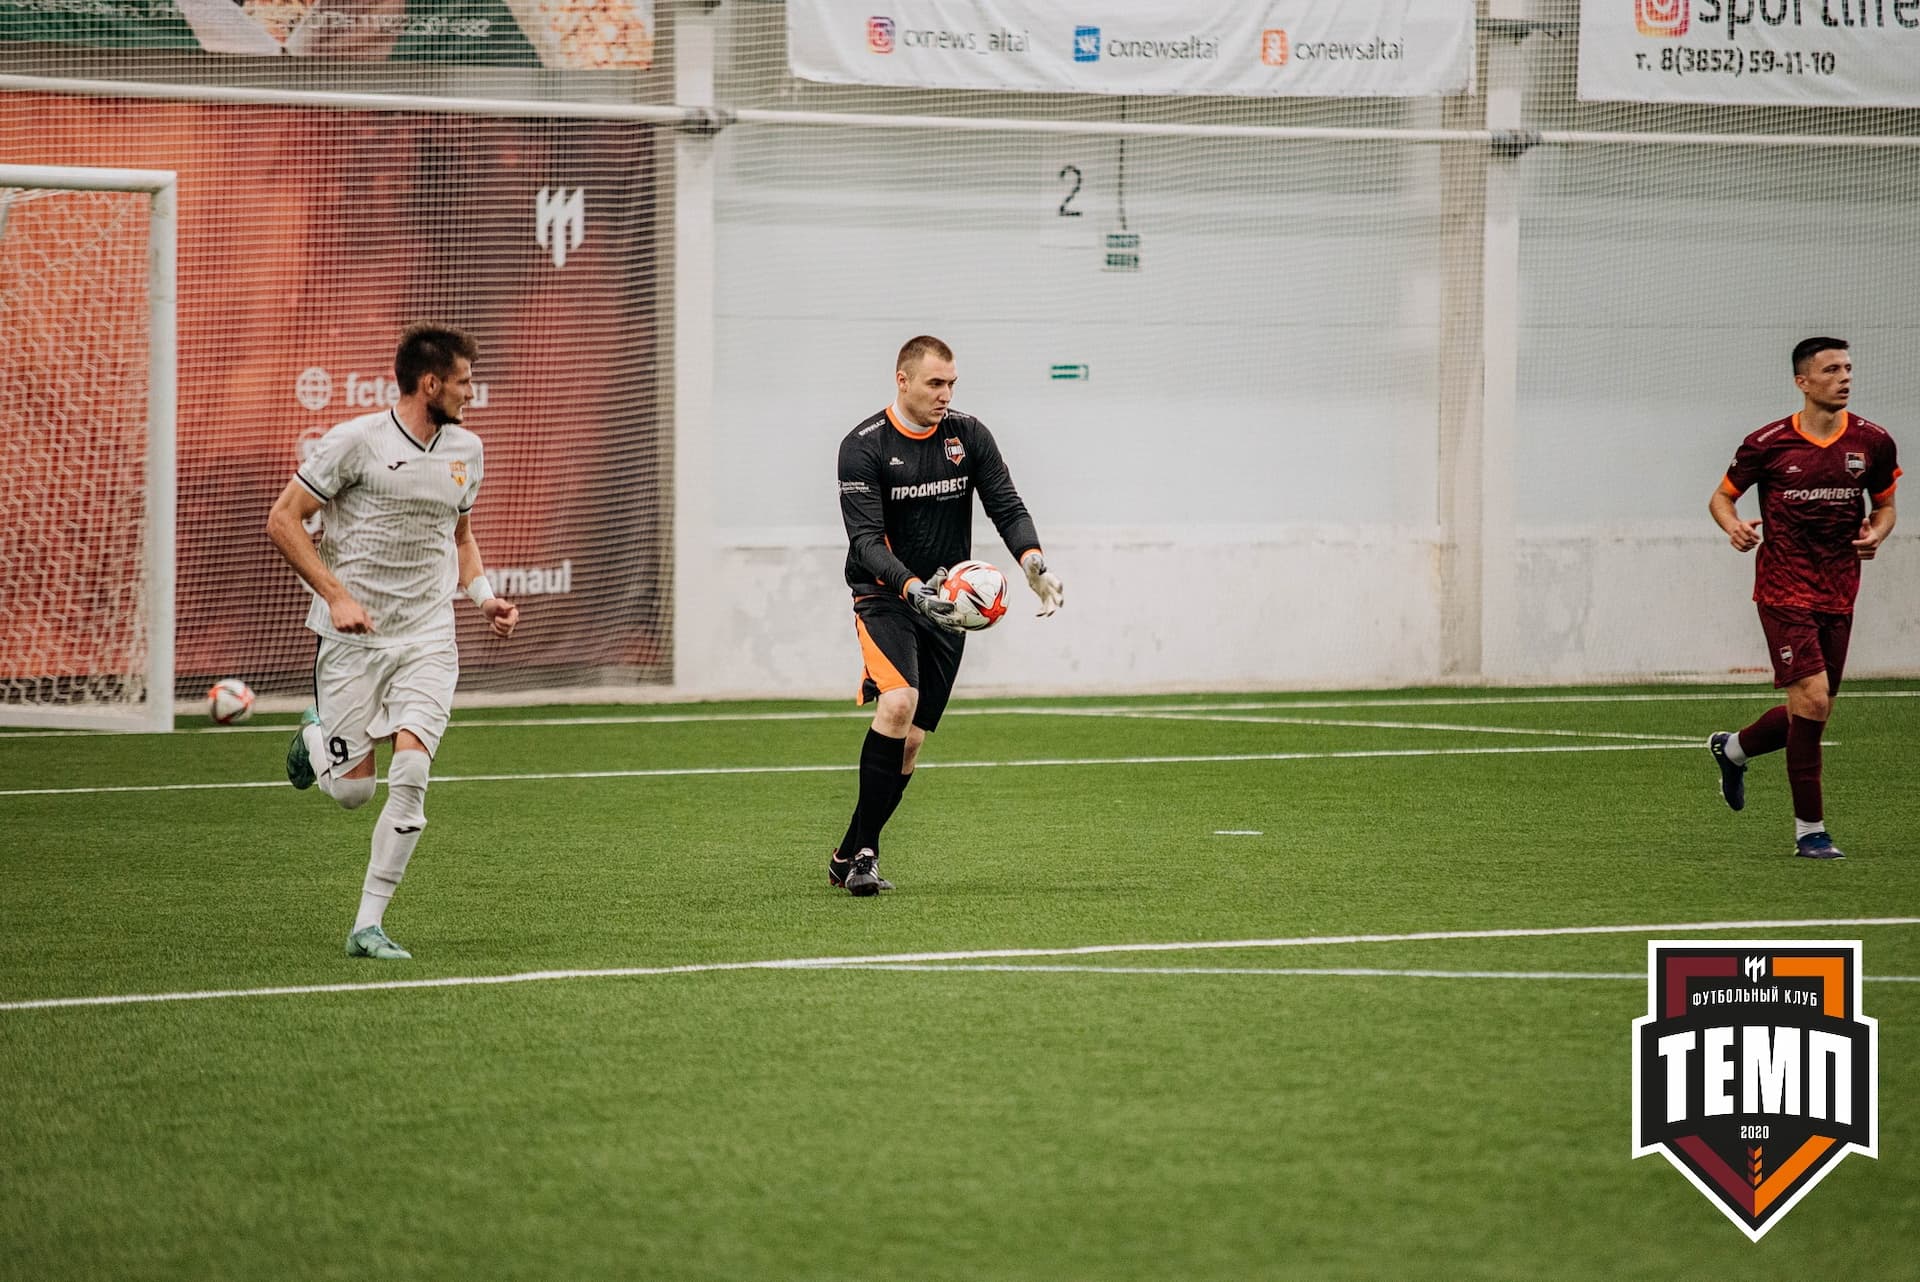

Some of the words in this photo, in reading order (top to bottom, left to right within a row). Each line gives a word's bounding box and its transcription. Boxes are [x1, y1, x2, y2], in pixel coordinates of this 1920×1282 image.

[1107, 35, 1220, 59] cxnewsaltai
[1294, 37, 1404, 60] cxnewsaltai
[1661, 46, 1744, 77] 8(3852)
[1749, 50, 1836, 75] 59-11-10
[1059, 165, 1083, 216] 2
[891, 476, 969, 501] ПРОДИНВЕСТ
[329, 736, 349, 767] 9
